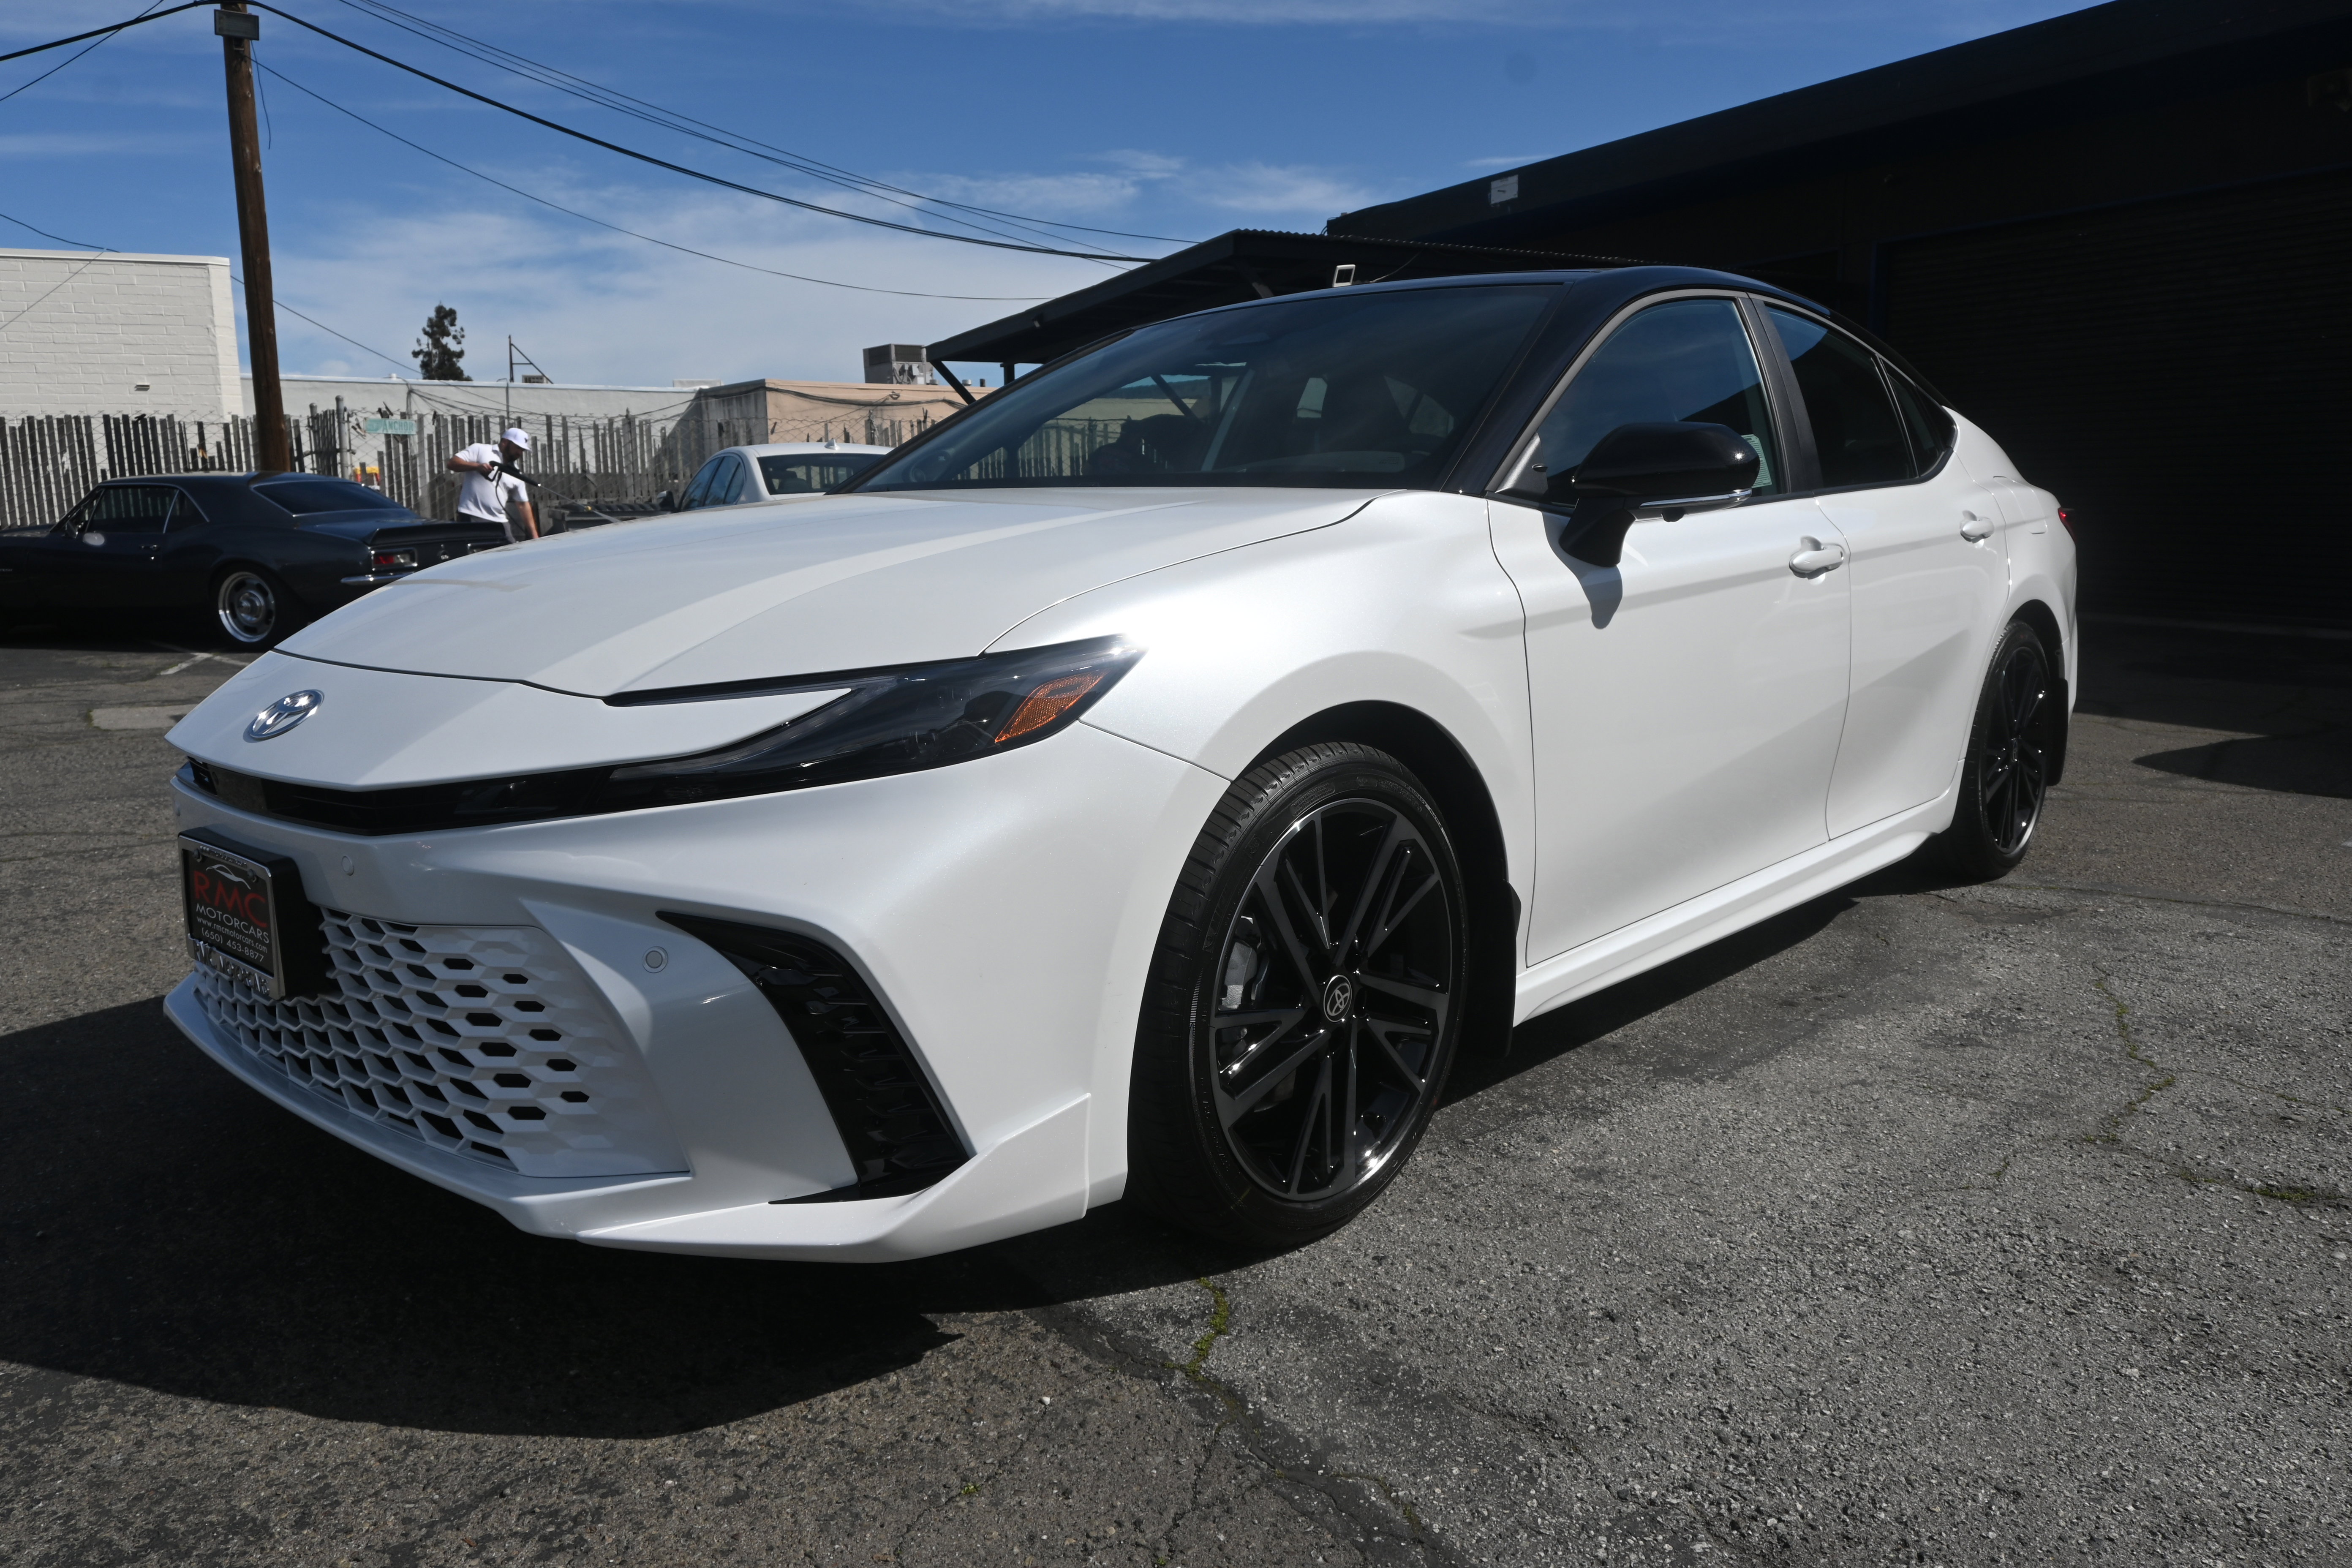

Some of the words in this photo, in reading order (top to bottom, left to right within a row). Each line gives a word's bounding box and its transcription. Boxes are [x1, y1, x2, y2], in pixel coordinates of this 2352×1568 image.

[382, 419, 414, 433] ANCHOR
[193, 870, 268, 928] RMC
[196, 903, 270, 944] MOTORCARS
[196, 916, 267, 953] www.rmcmotorcars.com
[201, 927, 223, 944] (650)
[226, 939, 264, 962] 453-8877
